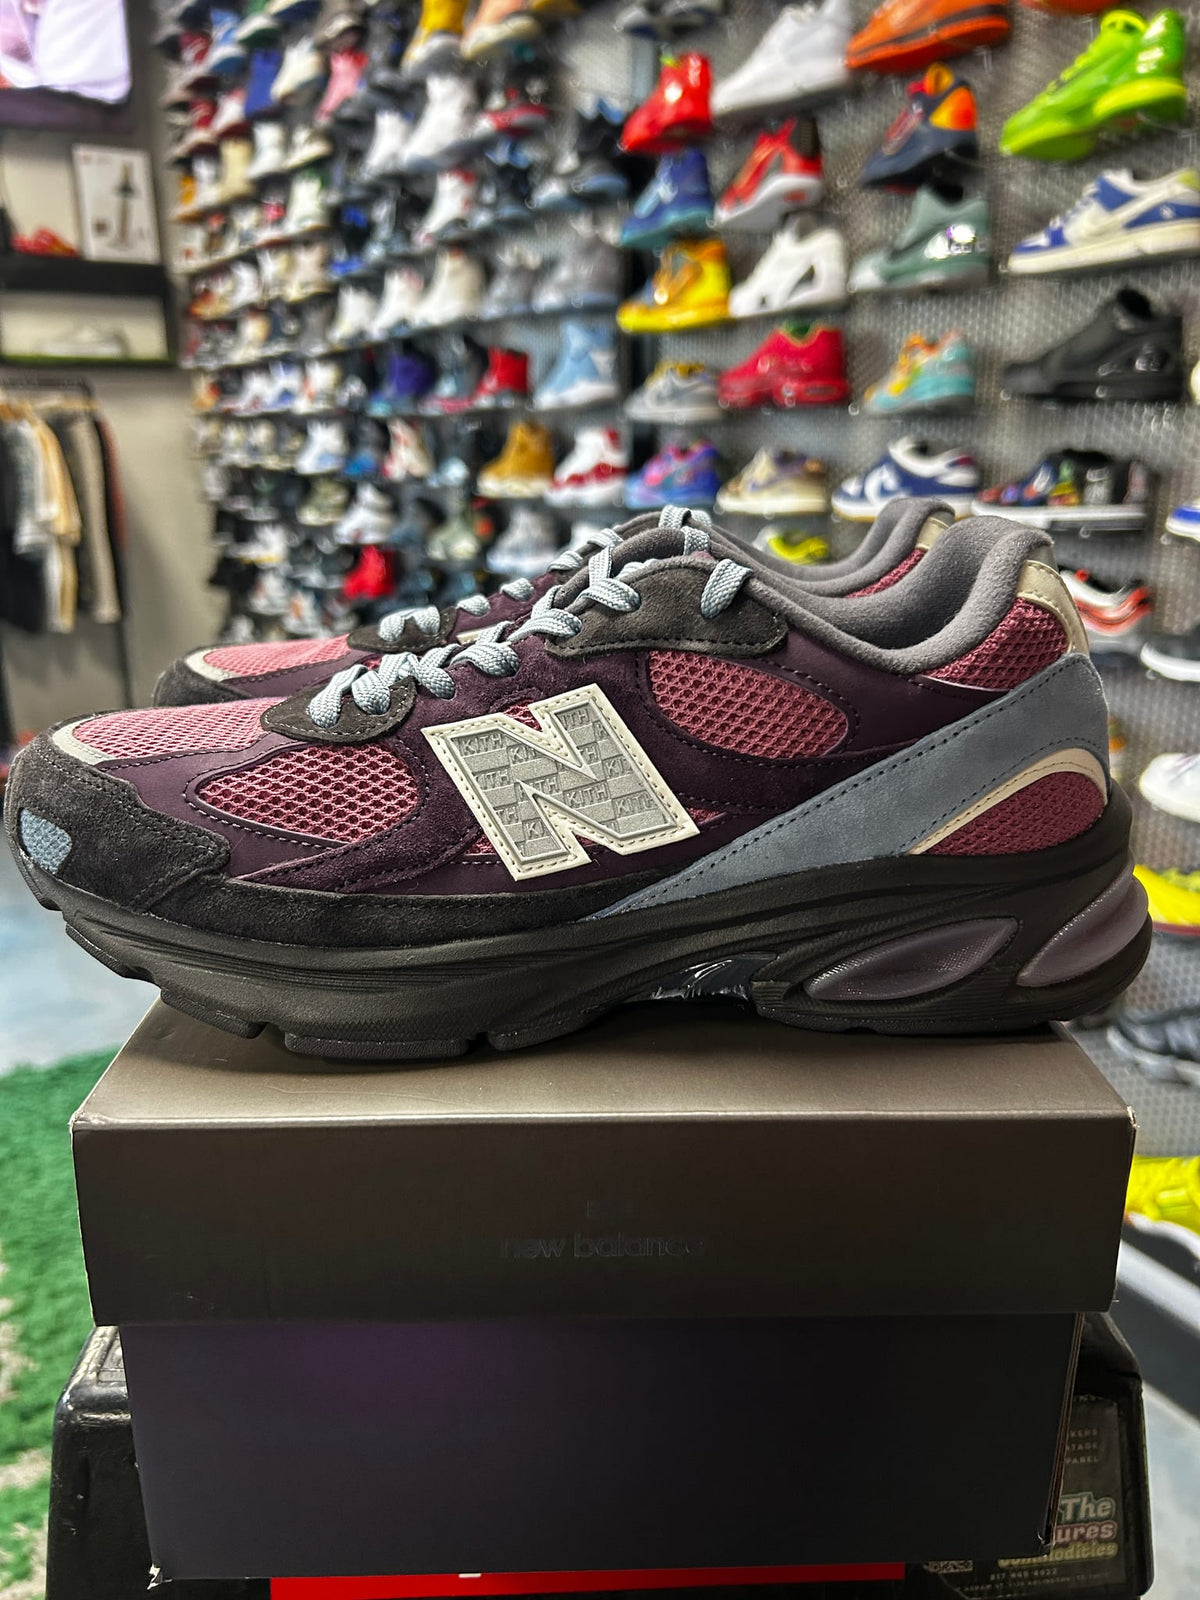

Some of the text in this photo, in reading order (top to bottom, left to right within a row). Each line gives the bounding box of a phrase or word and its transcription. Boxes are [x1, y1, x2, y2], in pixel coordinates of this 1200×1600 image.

[461, 733, 504, 756] KITH
[566, 784, 609, 808] KITH
[500, 1231, 705, 1258] new balance
[1060, 1494, 1113, 1521] The
[1056, 1523, 1115, 1544] ures
